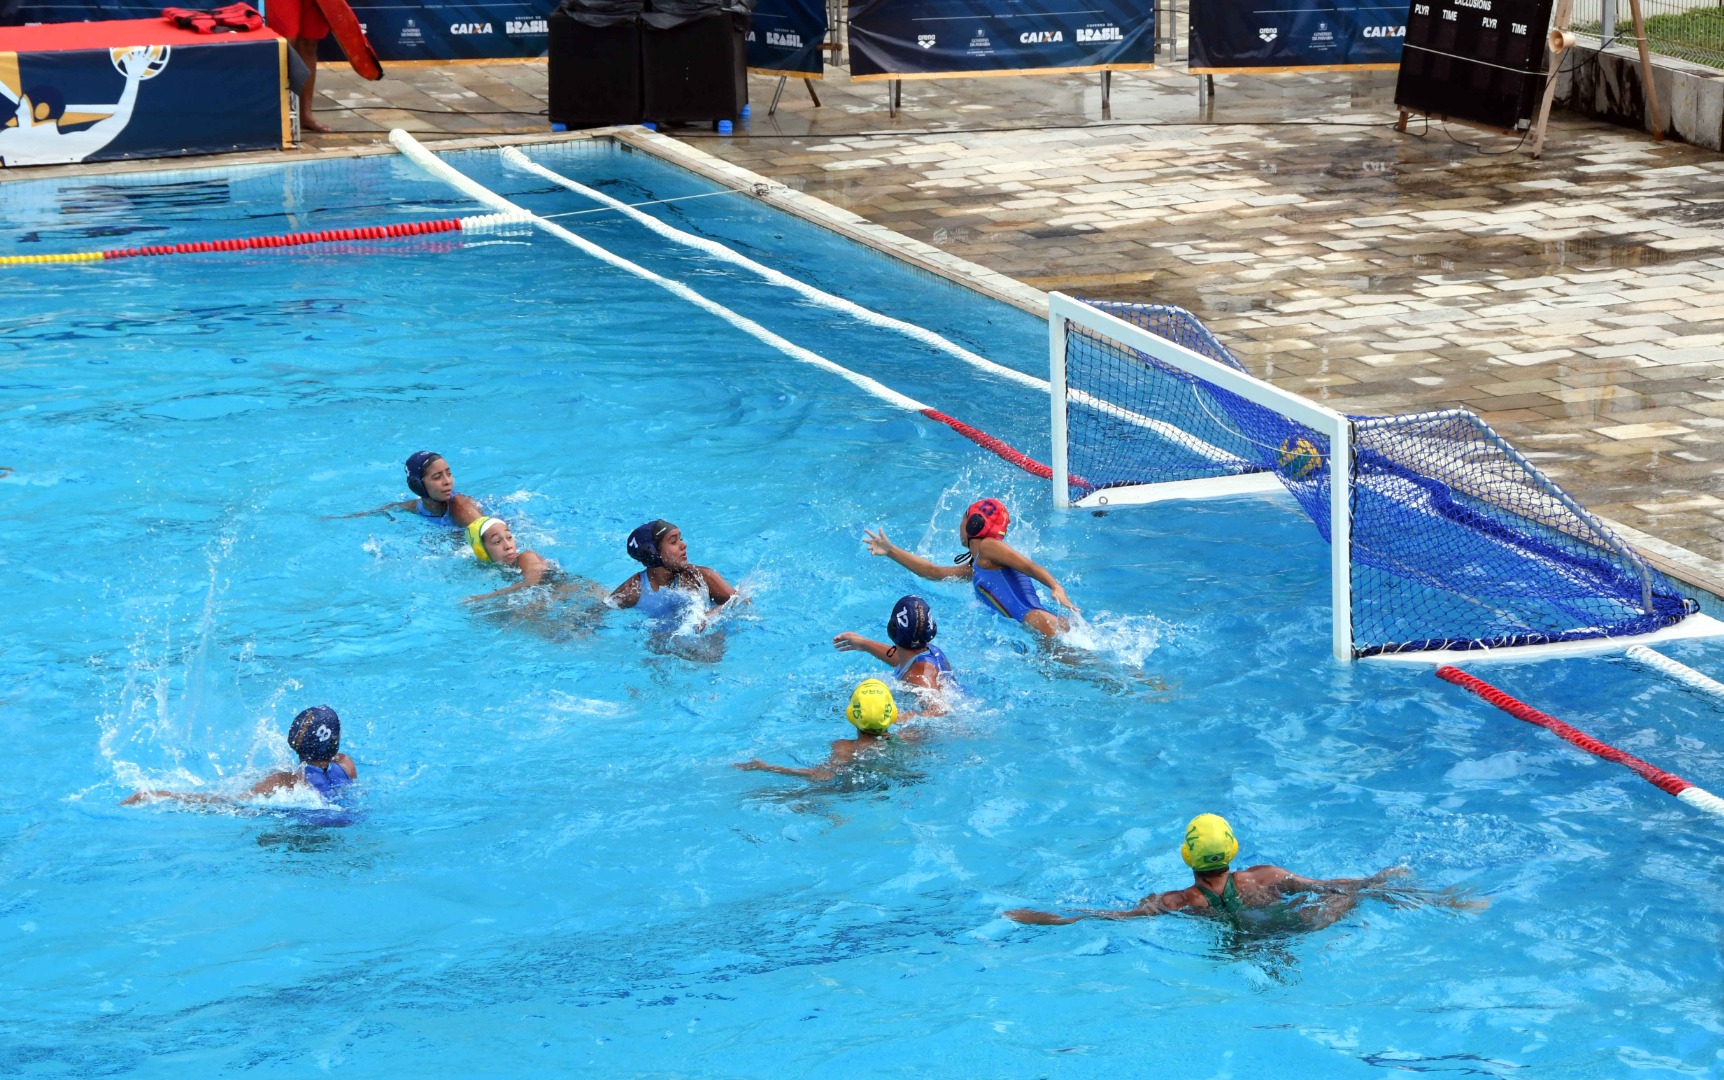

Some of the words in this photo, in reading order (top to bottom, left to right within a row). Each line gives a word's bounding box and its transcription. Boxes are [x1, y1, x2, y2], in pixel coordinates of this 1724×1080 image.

[1414, 3, 1430, 16] PLYR
[1442, 9, 1458, 21] TIME
[1481, 16, 1498, 29] PLYR
[1511, 22, 1528, 35] TIME
[450, 23, 493, 35] CAIXA
[505, 20, 549, 34] BRASIL
[1076, 27, 1124, 42] BRASIL
[1362, 25, 1407, 38] CAIXA
[766, 31, 803, 48] BRASIL
[1019, 30, 1063, 44] CAIXA
[896, 606, 909, 628] 12
[316, 724, 332, 742] 8
